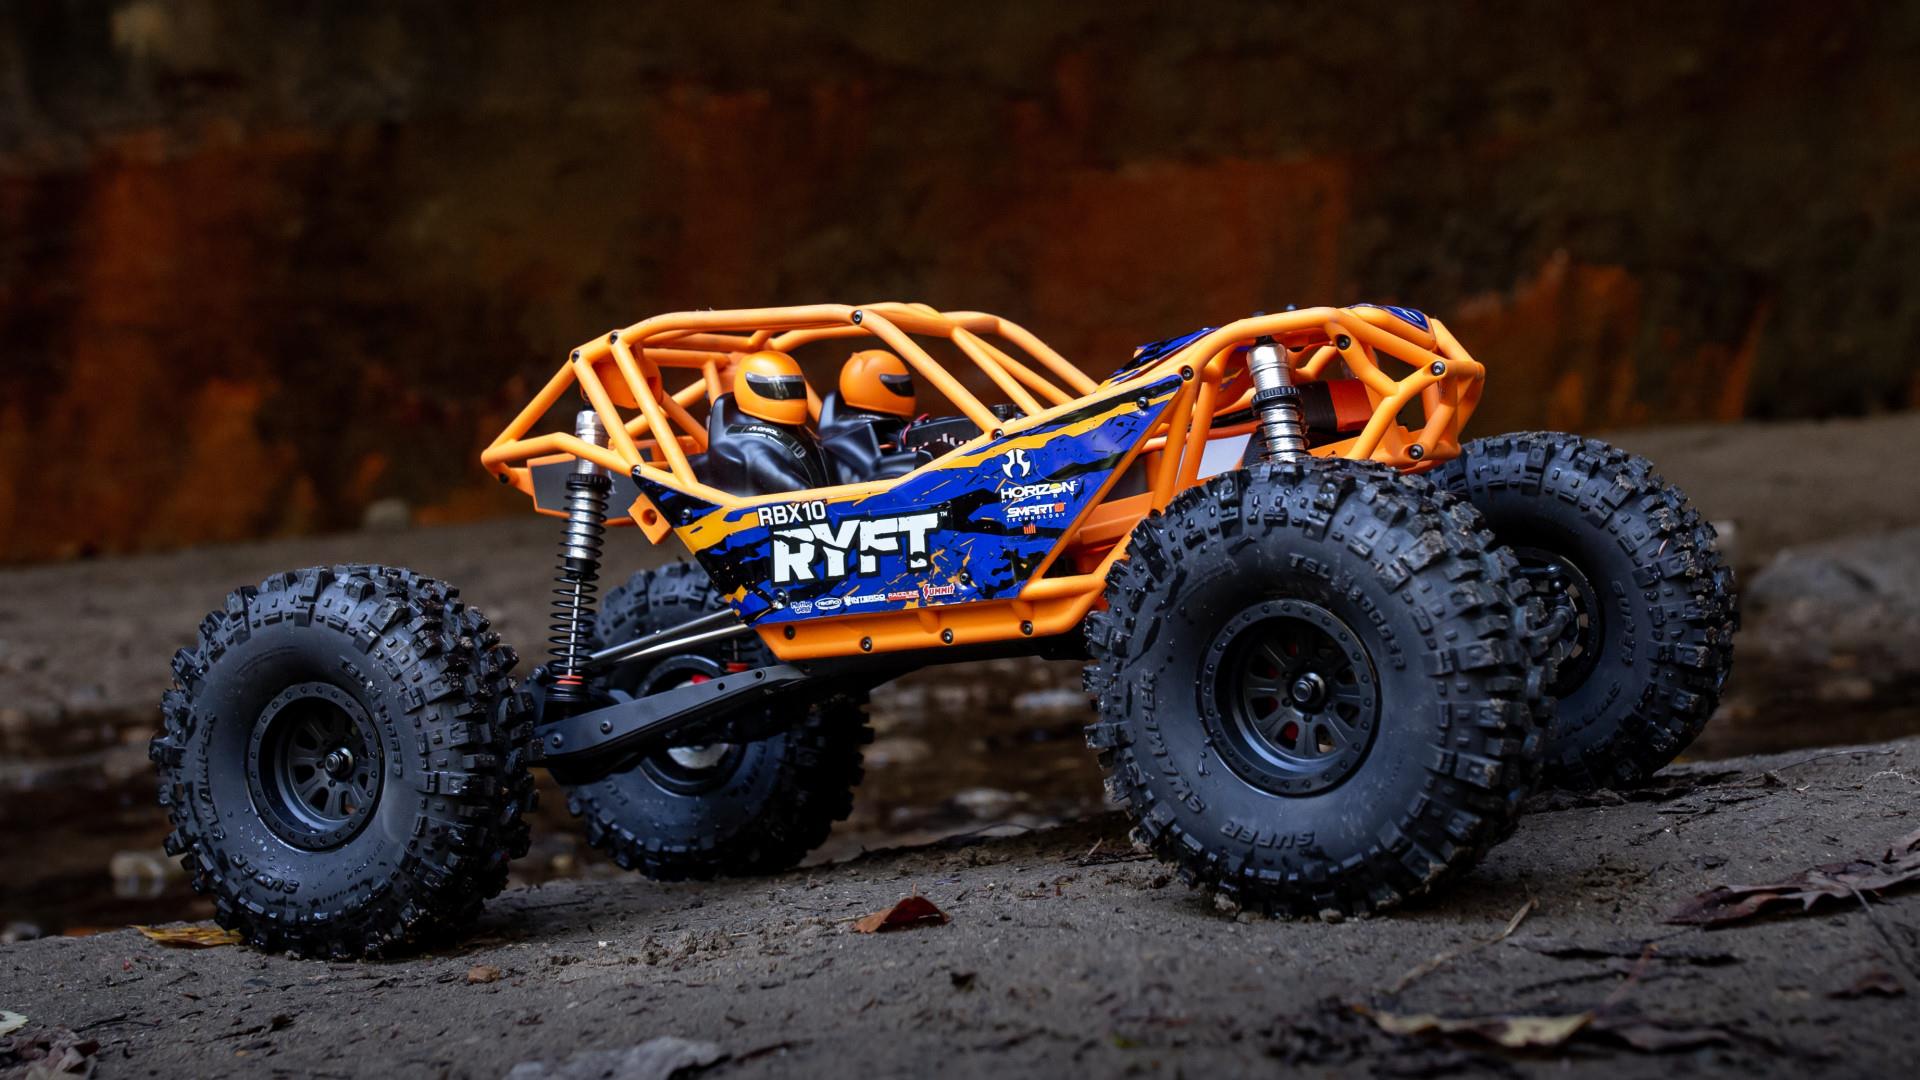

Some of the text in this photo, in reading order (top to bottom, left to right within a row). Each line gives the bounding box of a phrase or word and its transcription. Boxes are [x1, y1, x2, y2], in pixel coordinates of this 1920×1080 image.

[1000, 481, 1075, 499] HORIZON
[757, 501, 826, 527] RBX10
[1006, 513, 1066, 523] TECHNOLOGY
[1007, 504, 1054, 517] SMART
[773, 512, 938, 583] RYFT
[1141, 669, 1206, 814] SWAMPER
[1220, 820, 1316, 850] SUPER
